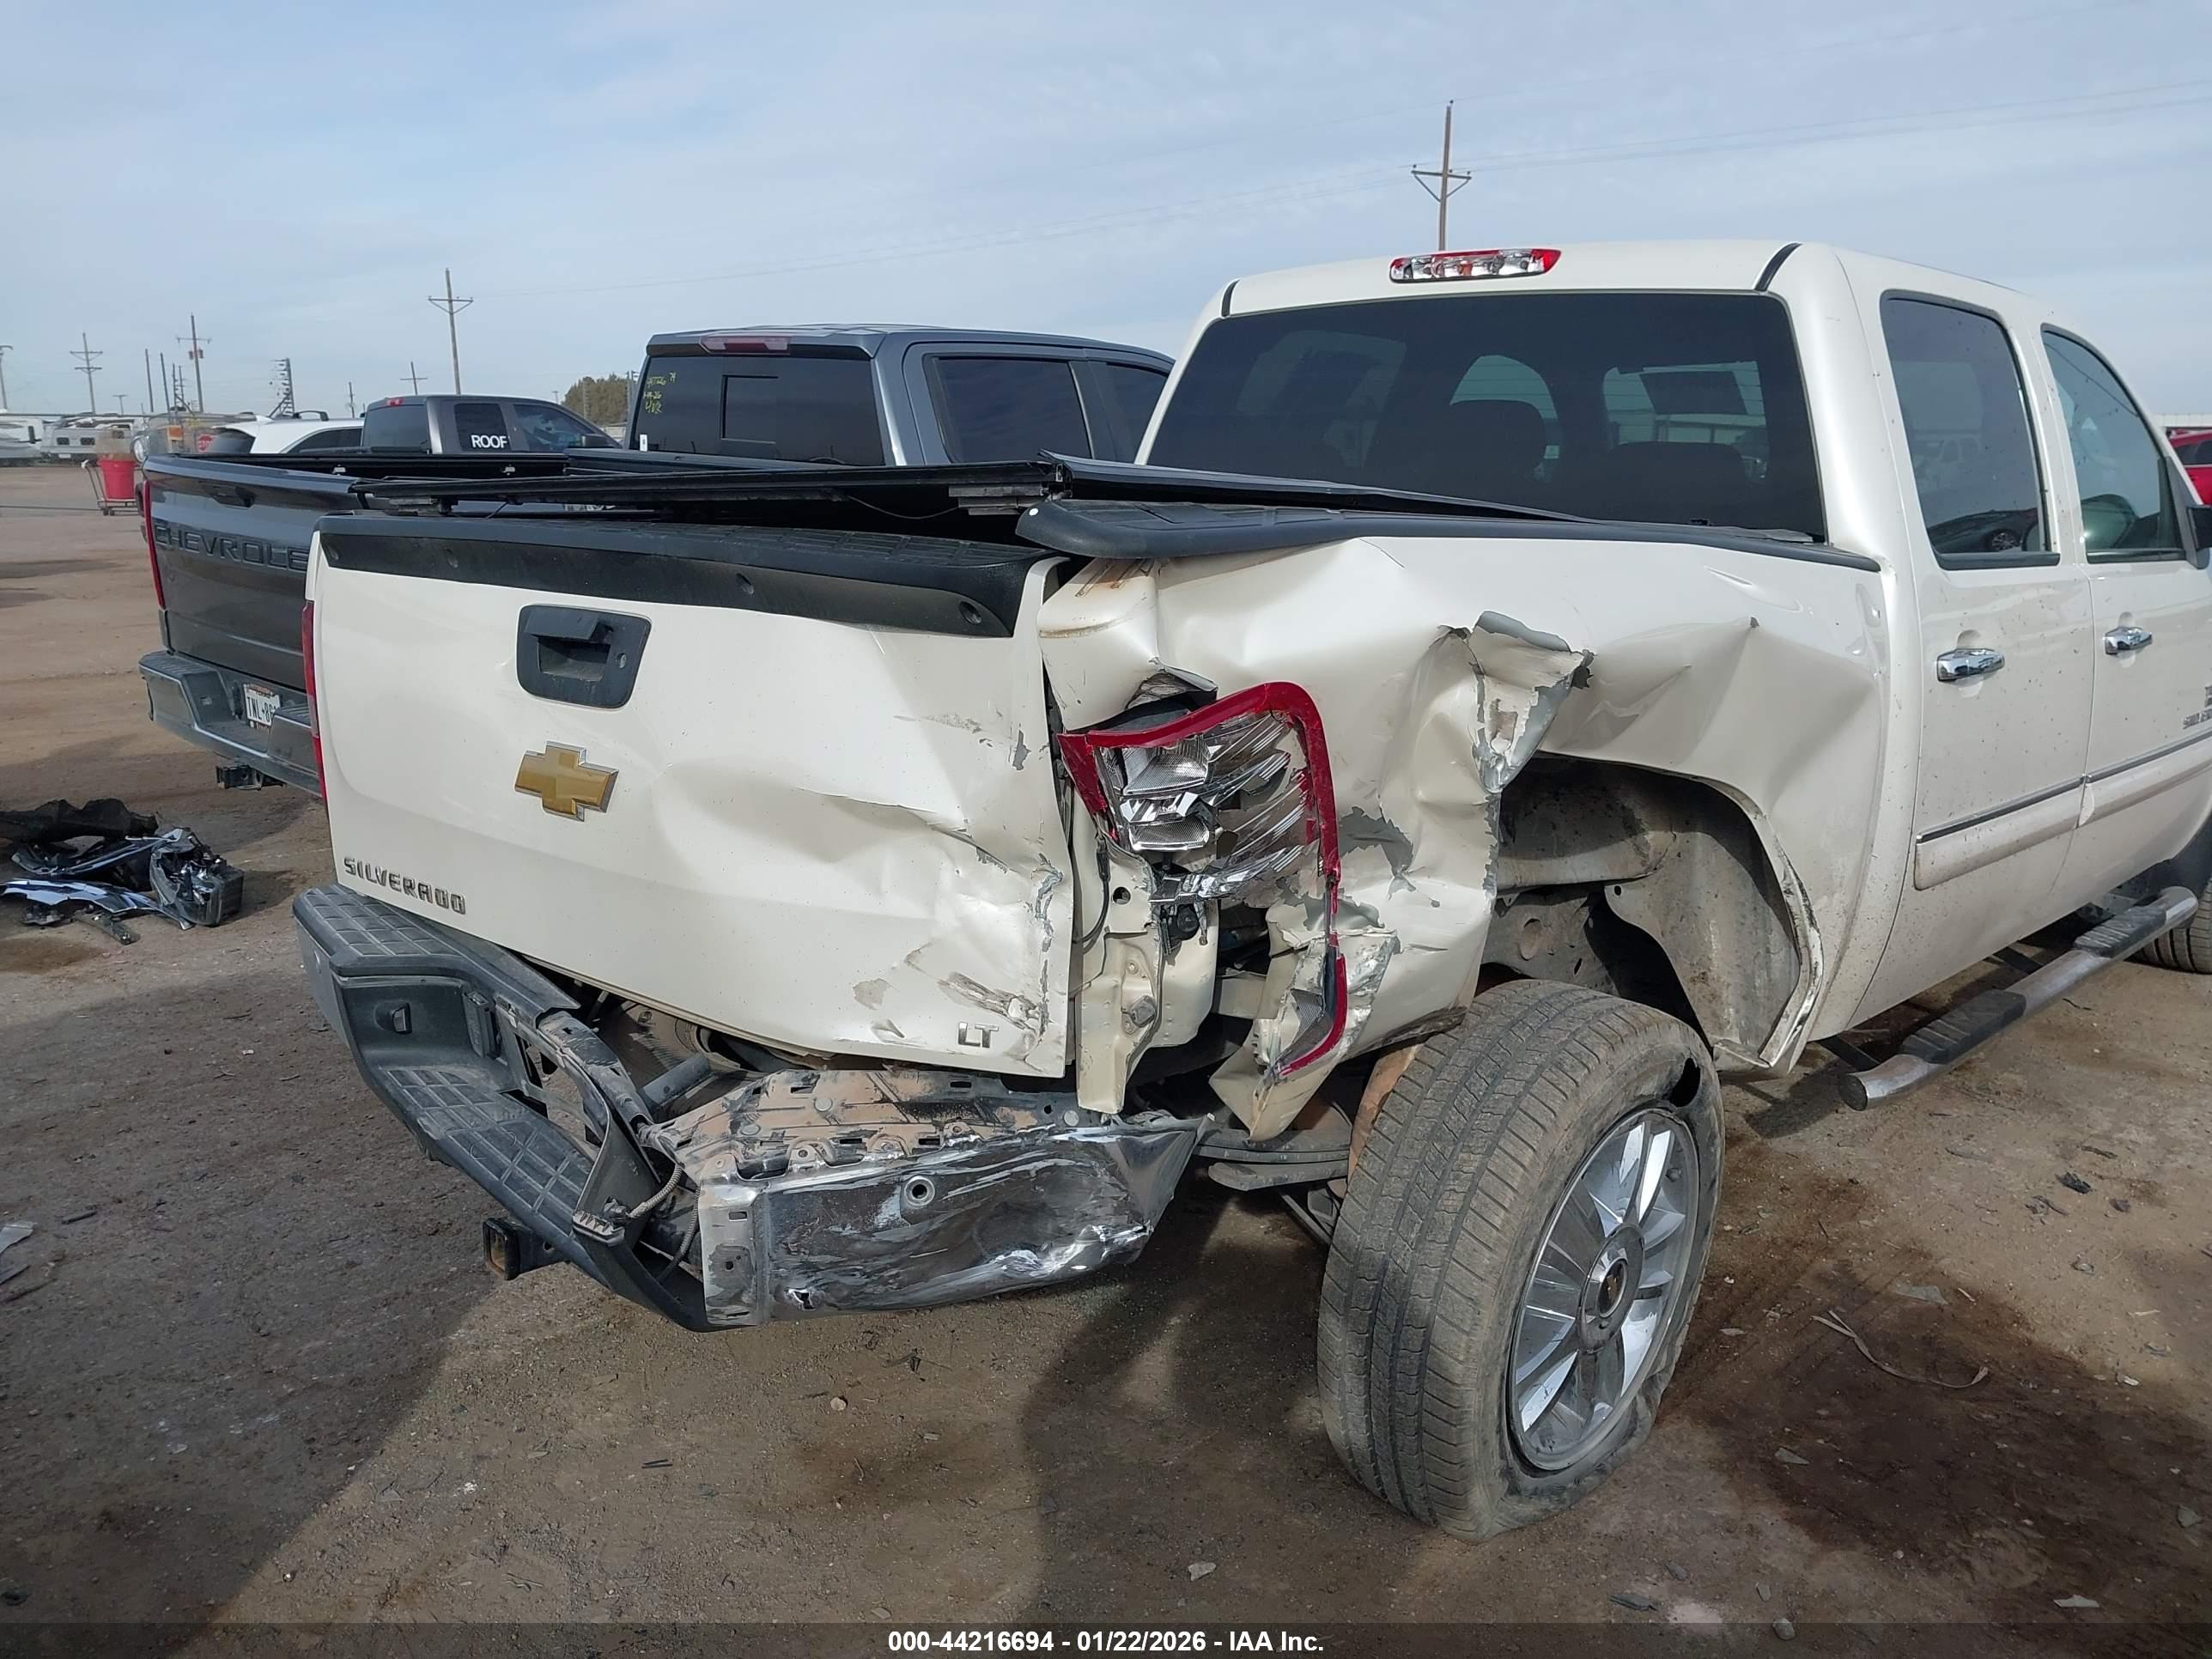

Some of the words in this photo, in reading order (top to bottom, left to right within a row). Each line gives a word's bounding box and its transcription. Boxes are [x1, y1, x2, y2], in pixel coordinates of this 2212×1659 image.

[471, 434, 507, 448] ROOF
[154, 524, 310, 574] CHEVROLE
[343, 857, 466, 915] SILVERADO
[957, 1021, 1000, 1048] LT
